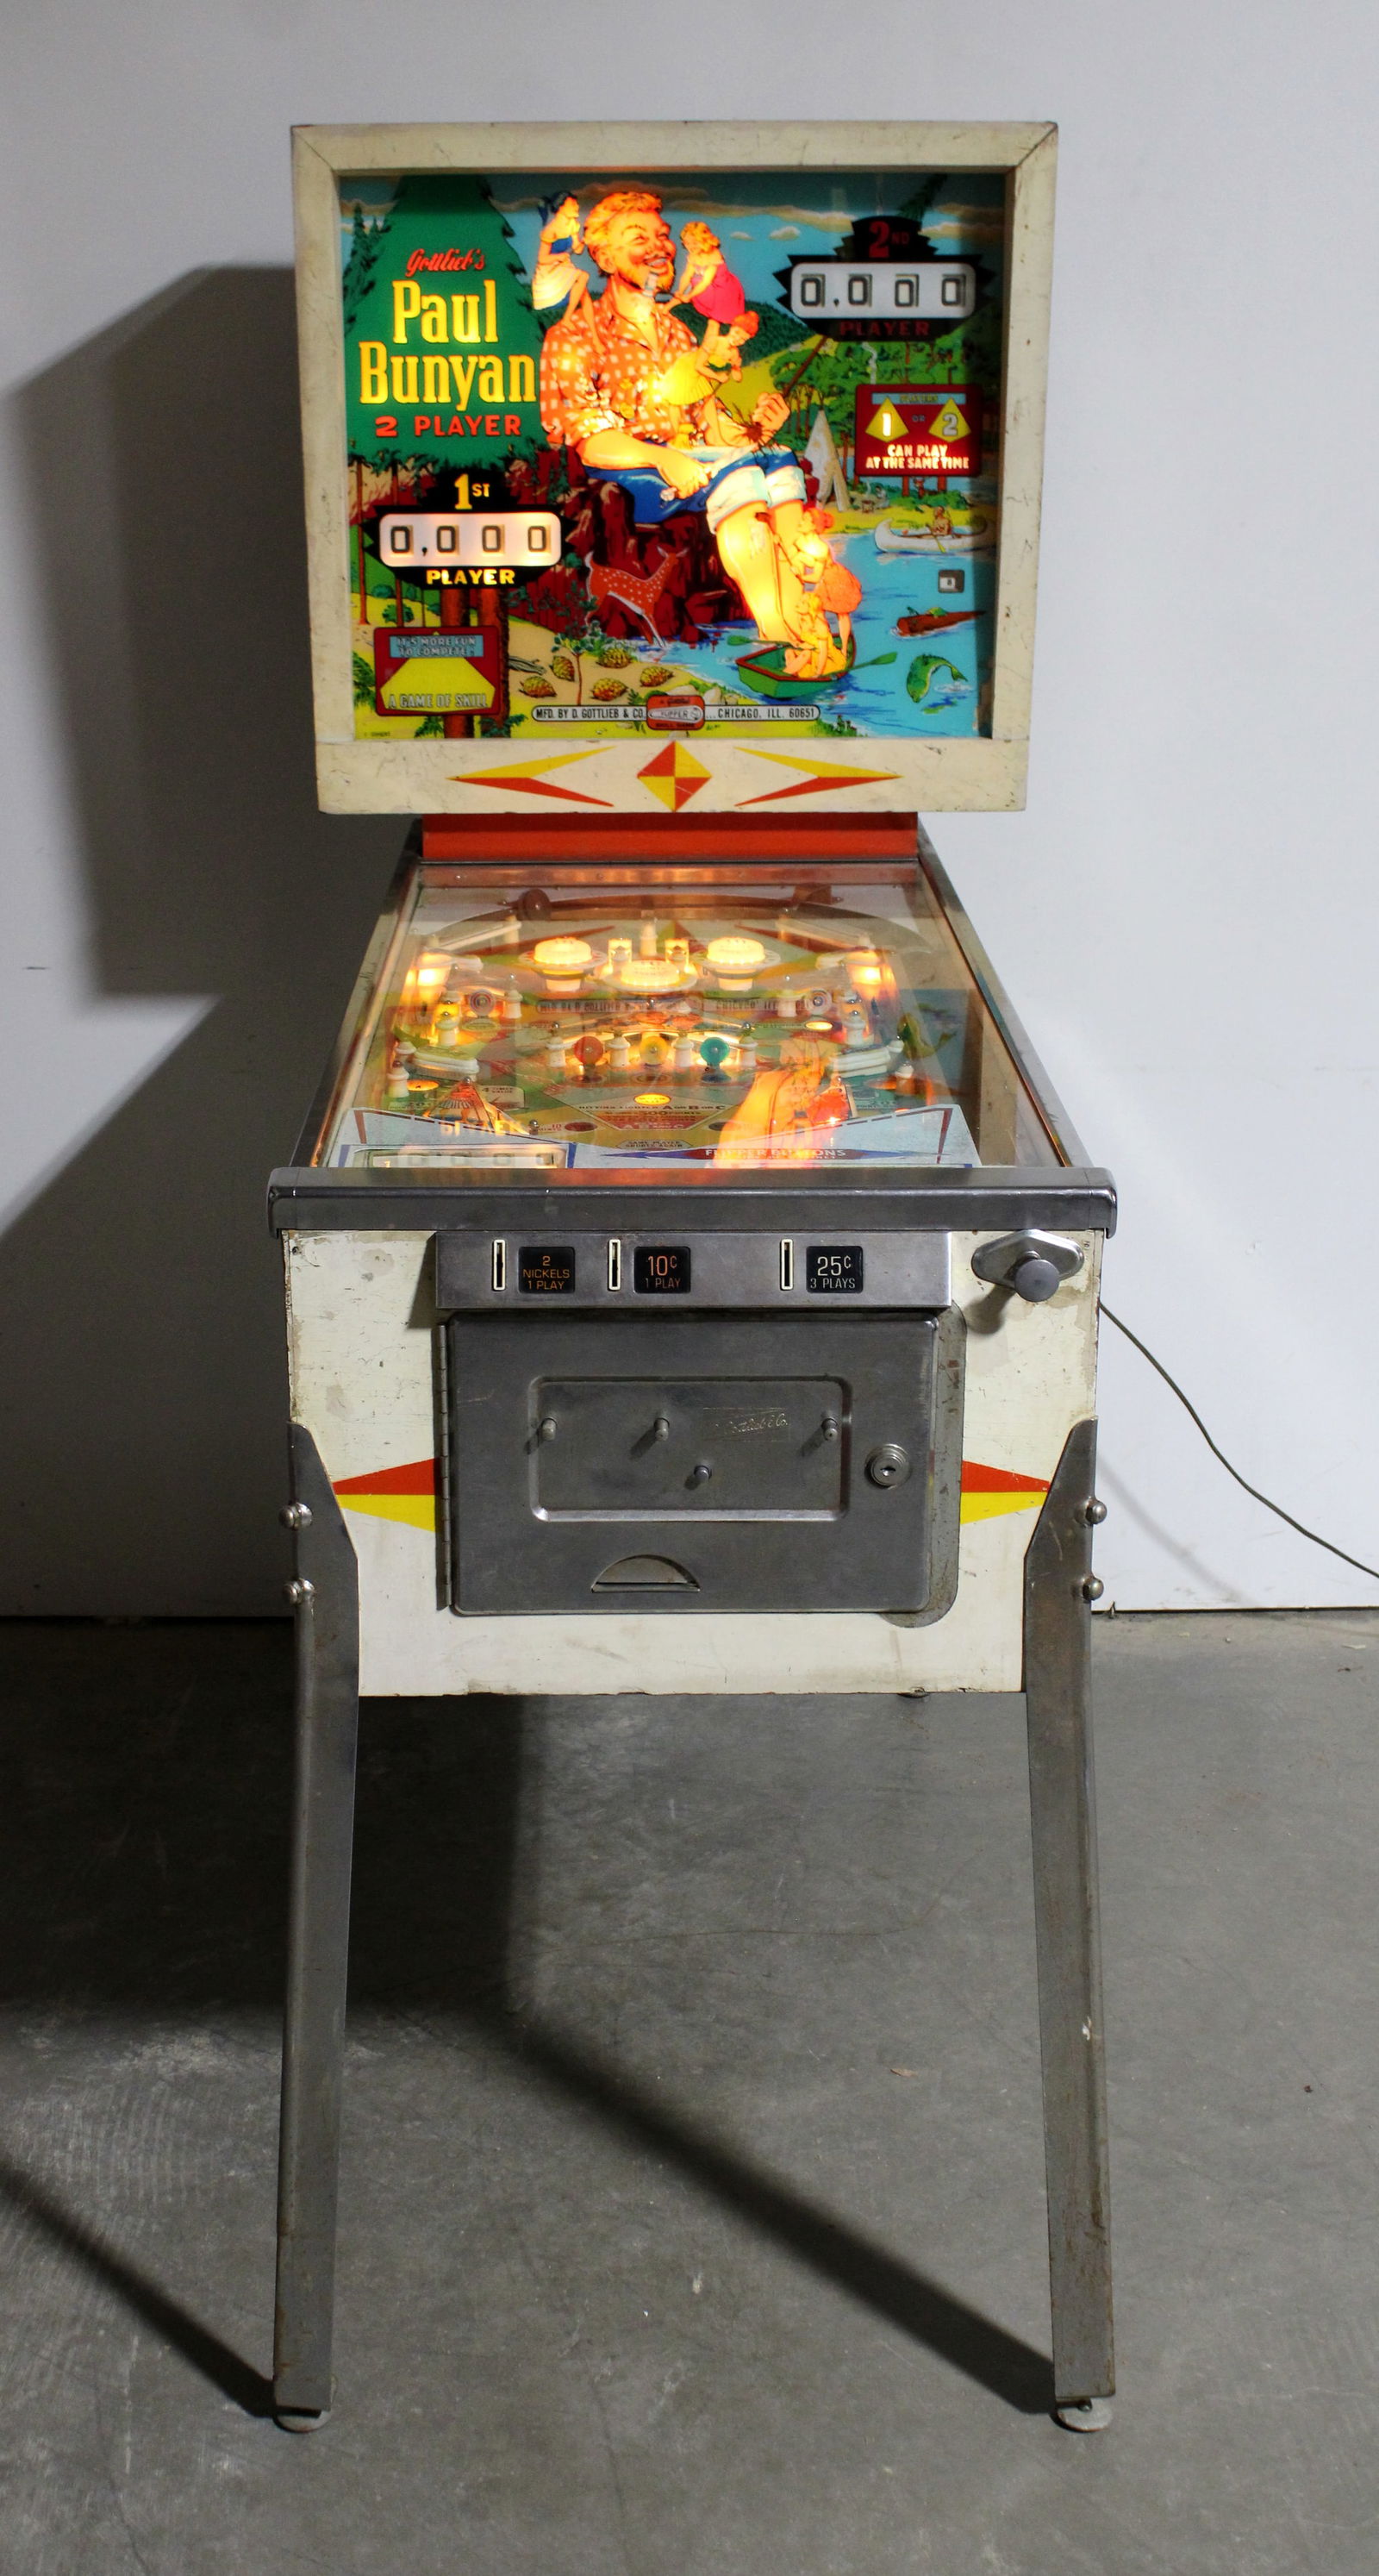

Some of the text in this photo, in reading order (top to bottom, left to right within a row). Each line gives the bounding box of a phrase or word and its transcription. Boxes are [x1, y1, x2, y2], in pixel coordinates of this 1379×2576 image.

[405, 248, 485, 277] Gottlieb's
[392, 279, 499, 344] Paul
[839, 321, 931, 336] PLAYER
[359, 341, 537, 411] Bunyan
[375, 415, 521, 437] 2 PLAYER
[882, 413, 892, 436] 1
[942, 414, 958, 436] 2
[887, 444, 948, 457] CAN PLAY
[865, 457, 970, 469] AT THE SAME TIME
[426, 569, 515, 585] PLAYER
[420, 636, 452, 646] MORE
[454, 636, 477, 646] FUN
[398, 647, 413, 656] TO
[388, 693, 488, 708] A GAME OF SKILL
[558, 709, 569, 719] BY
[582, 708, 619, 718] GOTTLIEB
[623, 709, 629, 718] &
[789, 708, 814, 718] 60651
[542, 1255, 552, 1266] 2
[522, 1268, 571, 1279] NICKELS
[527, 1280, 565, 1290] 1 PLAY
[645, 1278, 682, 1289] 1 PLAY
[810, 1278, 856, 1289] 3 PLAYS
